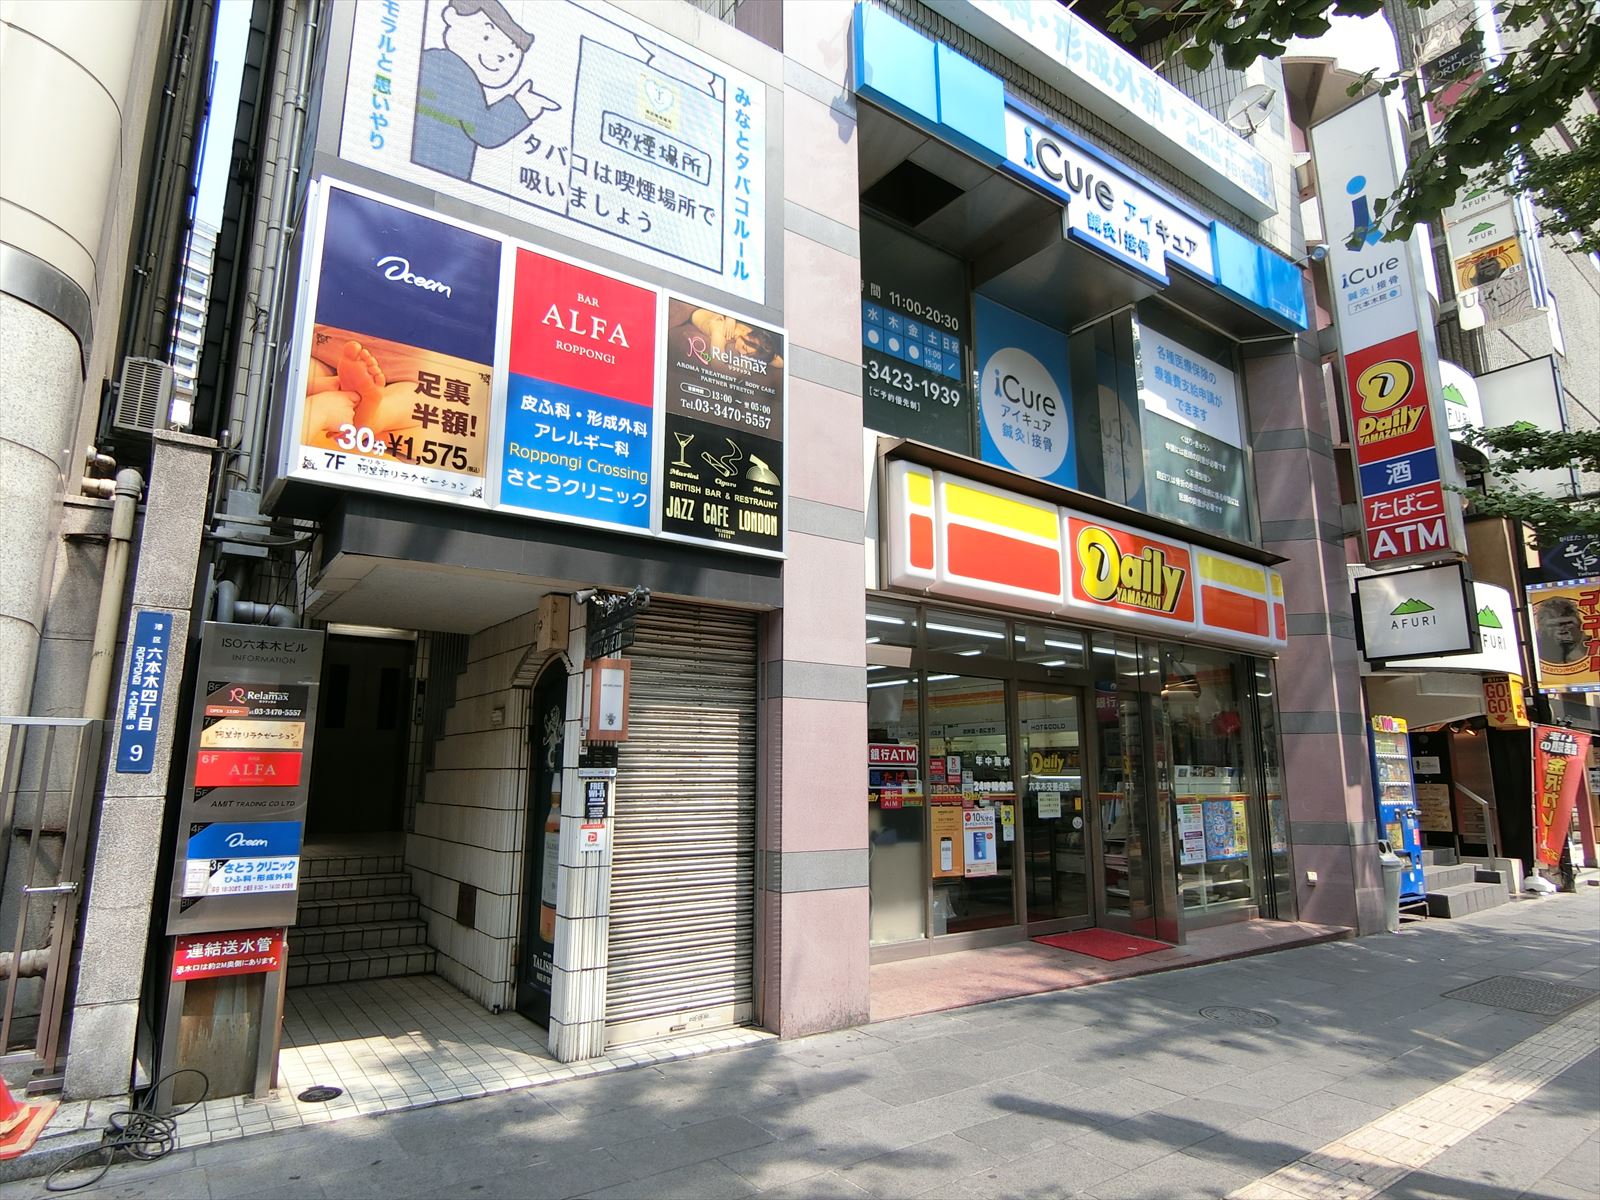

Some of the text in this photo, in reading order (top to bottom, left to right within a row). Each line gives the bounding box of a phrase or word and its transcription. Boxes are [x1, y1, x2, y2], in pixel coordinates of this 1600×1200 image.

[608, 122, 702, 177] 喫煙場所
[524, 133, 716, 226] タバコは喫煙場所で
[1023, 127, 1115, 210] iCure
[733, 87, 751, 281] みなとタバコルール
[520, 166, 652, 233] 吸いましょう
[1462, 195, 1491, 210] AFURI
[1123, 199, 1198, 257] アイキュア
[1468, 228, 1497, 245] AFURI
[377, 256, 452, 298] Ocean
[1342, 257, 1399, 289] iCure
[576, 293, 600, 308] BAR
[889, 291, 960, 331] 11:00-20:30
[541, 303, 631, 349] ALFA
[867, 308, 879, 321] 水
[888, 316, 899, 329] 木
[908, 323, 919, 338] 金
[928, 332, 938, 345] 土
[555, 340, 616, 365] ROPPONGI
[712, 346, 767, 376] Relamax
[924, 346, 942, 360] 11:00
[415, 370, 472, 406] 足裏
[701, 368, 737, 382] TREATMENT
[712, 390, 733, 404] 13:00
[993, 368, 1056, 417] iCure
[520, 393, 648, 438] 皮ふ科・形成外科
[1001, 404, 1052, 432] アイキュア
[1175, 398, 1208, 421] できます
[1358, 405, 1428, 441] Daily
[388, 432, 469, 470] ¥1,575
[534, 422, 630, 458] アレルギー科
[324, 452, 346, 470] 7F
[509, 442, 648, 484] Roppongi Crossing
[1385, 460, 1412, 486] 酒
[507, 467, 648, 509] さとうクリニック
[670, 481, 702, 494] BRITISH
[705, 488, 722, 499] BAR
[734, 494, 778, 509] RESTRAUNT
[666, 495, 695, 521] JAZZ
[703, 502, 729, 528] CAFE
[739, 509, 778, 537] LONDON
[1371, 490, 1438, 522] たばこ
[1373, 518, 1446, 558] ATM
[1077, 526, 1186, 613] Daily
[1117, 587, 1162, 610] YAMAZAKI
[1391, 615, 1437, 630] AFURI
[221, 638, 308, 653] ISO六本木ビル
[232, 654, 296, 665] INFORMATION
[132, 646, 146, 685] ROPPONGI
[138, 647, 163, 731] 六本木四丁目
[247, 690, 290, 701] Relamax
[1485, 684, 1509, 699] GO!
[1488, 699, 1513, 713] GO!
[129, 744, 143, 762] 9
[870, 748, 916, 761] 銀行ATM
[1031, 752, 1065, 774] Daily
[228, 763, 276, 776] ALFA
[590, 782, 604, 790] FREE
[225, 832, 268, 848] Ocean
[210, 860, 223, 871] 3F
[186, 937, 273, 959] 連結送水管
